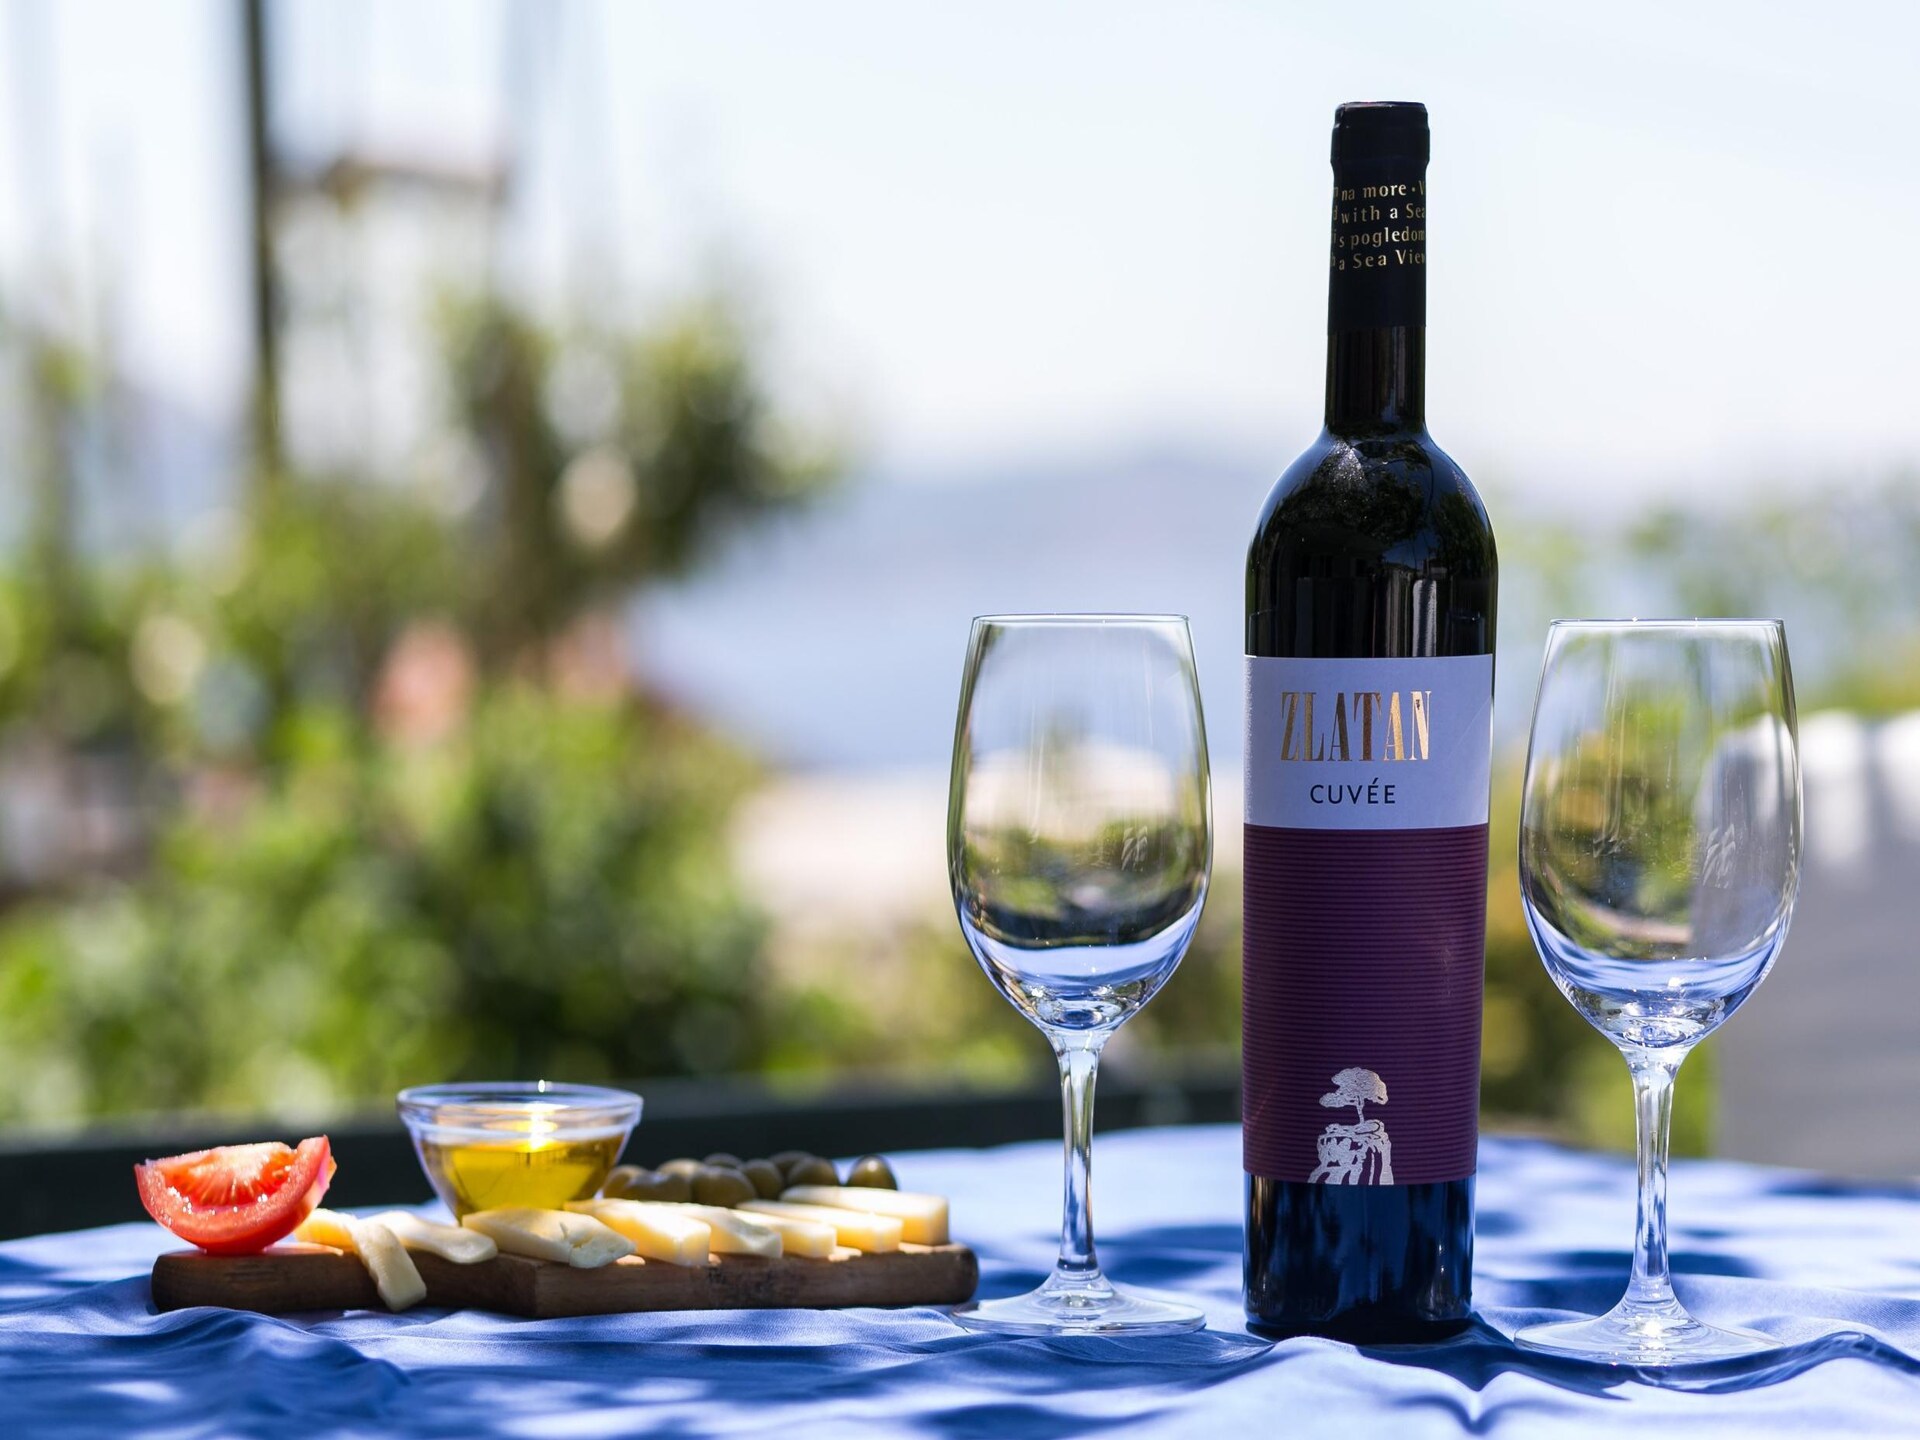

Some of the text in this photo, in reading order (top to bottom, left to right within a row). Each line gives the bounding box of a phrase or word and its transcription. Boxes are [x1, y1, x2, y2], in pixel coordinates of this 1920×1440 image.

[1341, 188, 1355, 201] na
[1362, 183, 1407, 198] more
[1341, 205, 1380, 224] with
[1389, 207, 1399, 220] a
[1352, 253, 1388, 269] Sea
[1280, 690, 1432, 762] ZLATAN
[1310, 777, 1396, 804] CUVÉE
